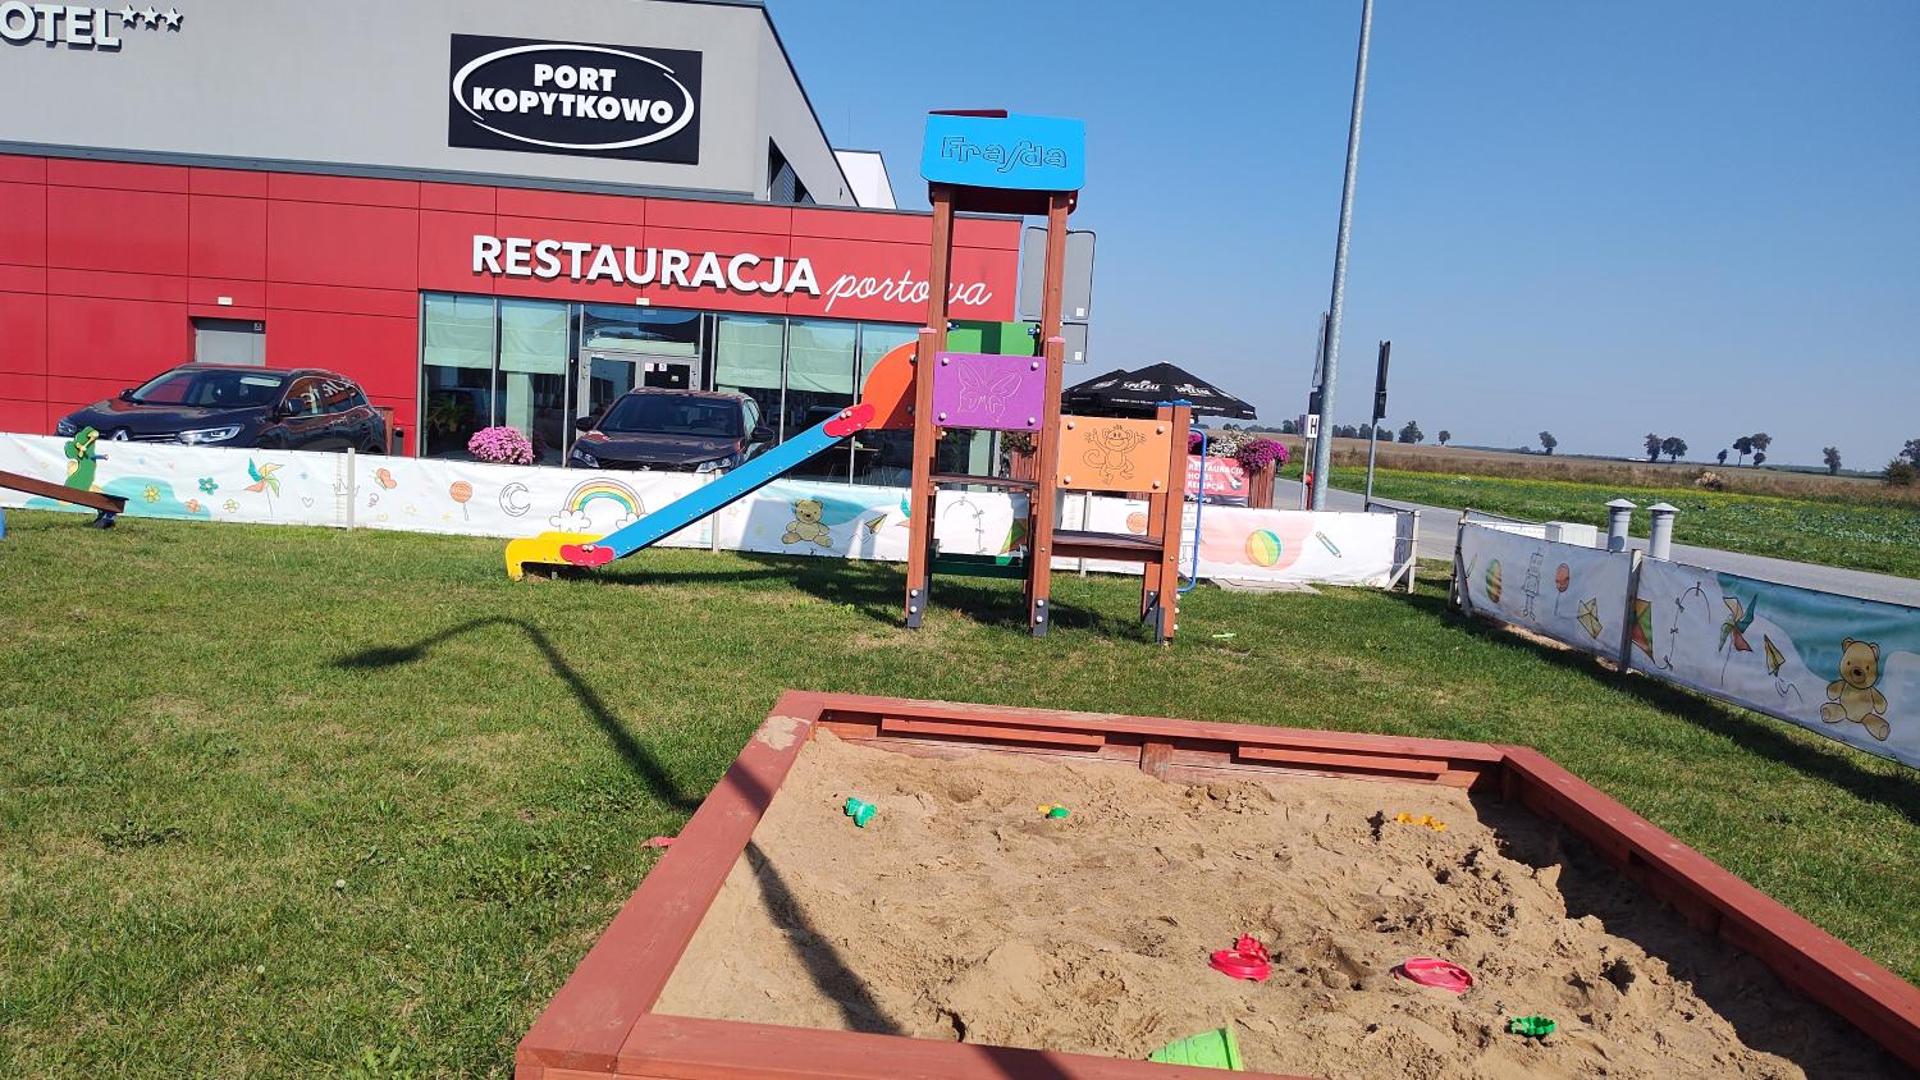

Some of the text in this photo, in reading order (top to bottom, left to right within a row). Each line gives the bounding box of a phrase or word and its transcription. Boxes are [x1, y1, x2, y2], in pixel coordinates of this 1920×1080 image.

[533, 63, 617, 92] PORT
[472, 86, 674, 124] KOPYTKOWO
[941, 136, 1067, 174] Frajda
[472, 234, 821, 297] RESTAURACJA
[1310, 417, 1318, 435] H
[1188, 463, 1244, 474] RETAURACJA
[1188, 472, 1212, 481] HOEL
